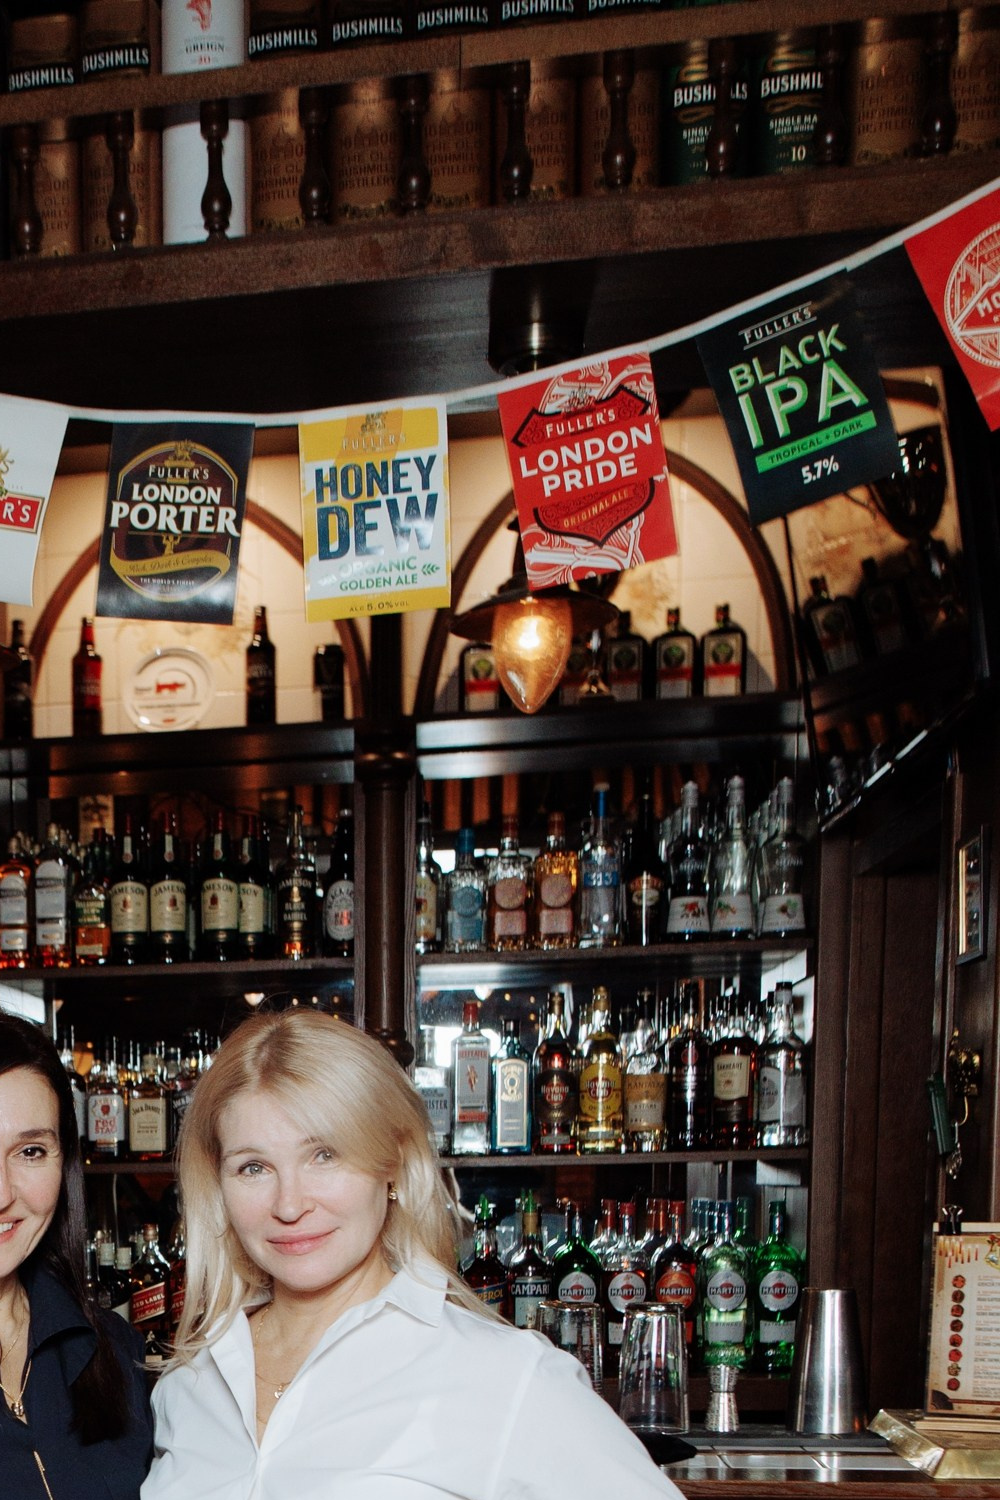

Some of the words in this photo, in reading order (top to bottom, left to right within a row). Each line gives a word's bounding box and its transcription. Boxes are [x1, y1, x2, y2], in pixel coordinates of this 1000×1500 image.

[417, 7, 489, 31] BUSHMILLS
[501, 0, 575, 22] BUSHMILLS
[332, 16, 403, 43] BUSHMILLS
[248, 28, 318, 57] BUSHMILLS
[83, 46, 149, 73] BUSHMILLS
[8, 67, 75, 91] BUSHMILLS
[761, 71, 824, 98] BUSHMIL
[804, 114, 818, 124] MA
[683, 125, 712, 140] SINGL
[791, 145, 807, 162] 10
[728, 323, 848, 394] BLACK
[738, 358, 870, 449] IPA
[545, 408, 616, 438] FULLER'S
[519, 422, 653, 478] LONDON
[767, 436, 822, 464] TROPICAL
[834, 420, 864, 440] DARK
[149, 465, 210, 480] FULLER'S
[315, 454, 437, 504] HONEY
[542, 453, 638, 497] PRIDE
[801, 454, 839, 485] 5.7%
[132, 483, 221, 505] LONDON
[110, 500, 241, 537] PORTER
[563, 501, 609, 528] ORIGINAL
[611, 488, 629, 503] ALE
[317, 493, 438, 561] DEW
[339, 556, 418, 578] ORGANIC
[339, 576, 392, 592] GOLDEN
[395, 573, 418, 586] ALE
[541, 1084, 569, 1095] Havana
[546, 1093, 563, 1102] Club
[591, 1088, 610, 1098] Club
[145, 1294, 165, 1304] LABEL
[477, 1289, 503, 1301] PEROL
[511, 1281, 550, 1296] CAMPARI
[561, 1288, 594, 1297] MARTINI
[610, 1288, 644, 1297] MARTINI
[659, 1287, 692, 1295] MARTINI
[710, 1286, 744, 1295] MARTINI
[762, 1286, 796, 1295] MARTINI
